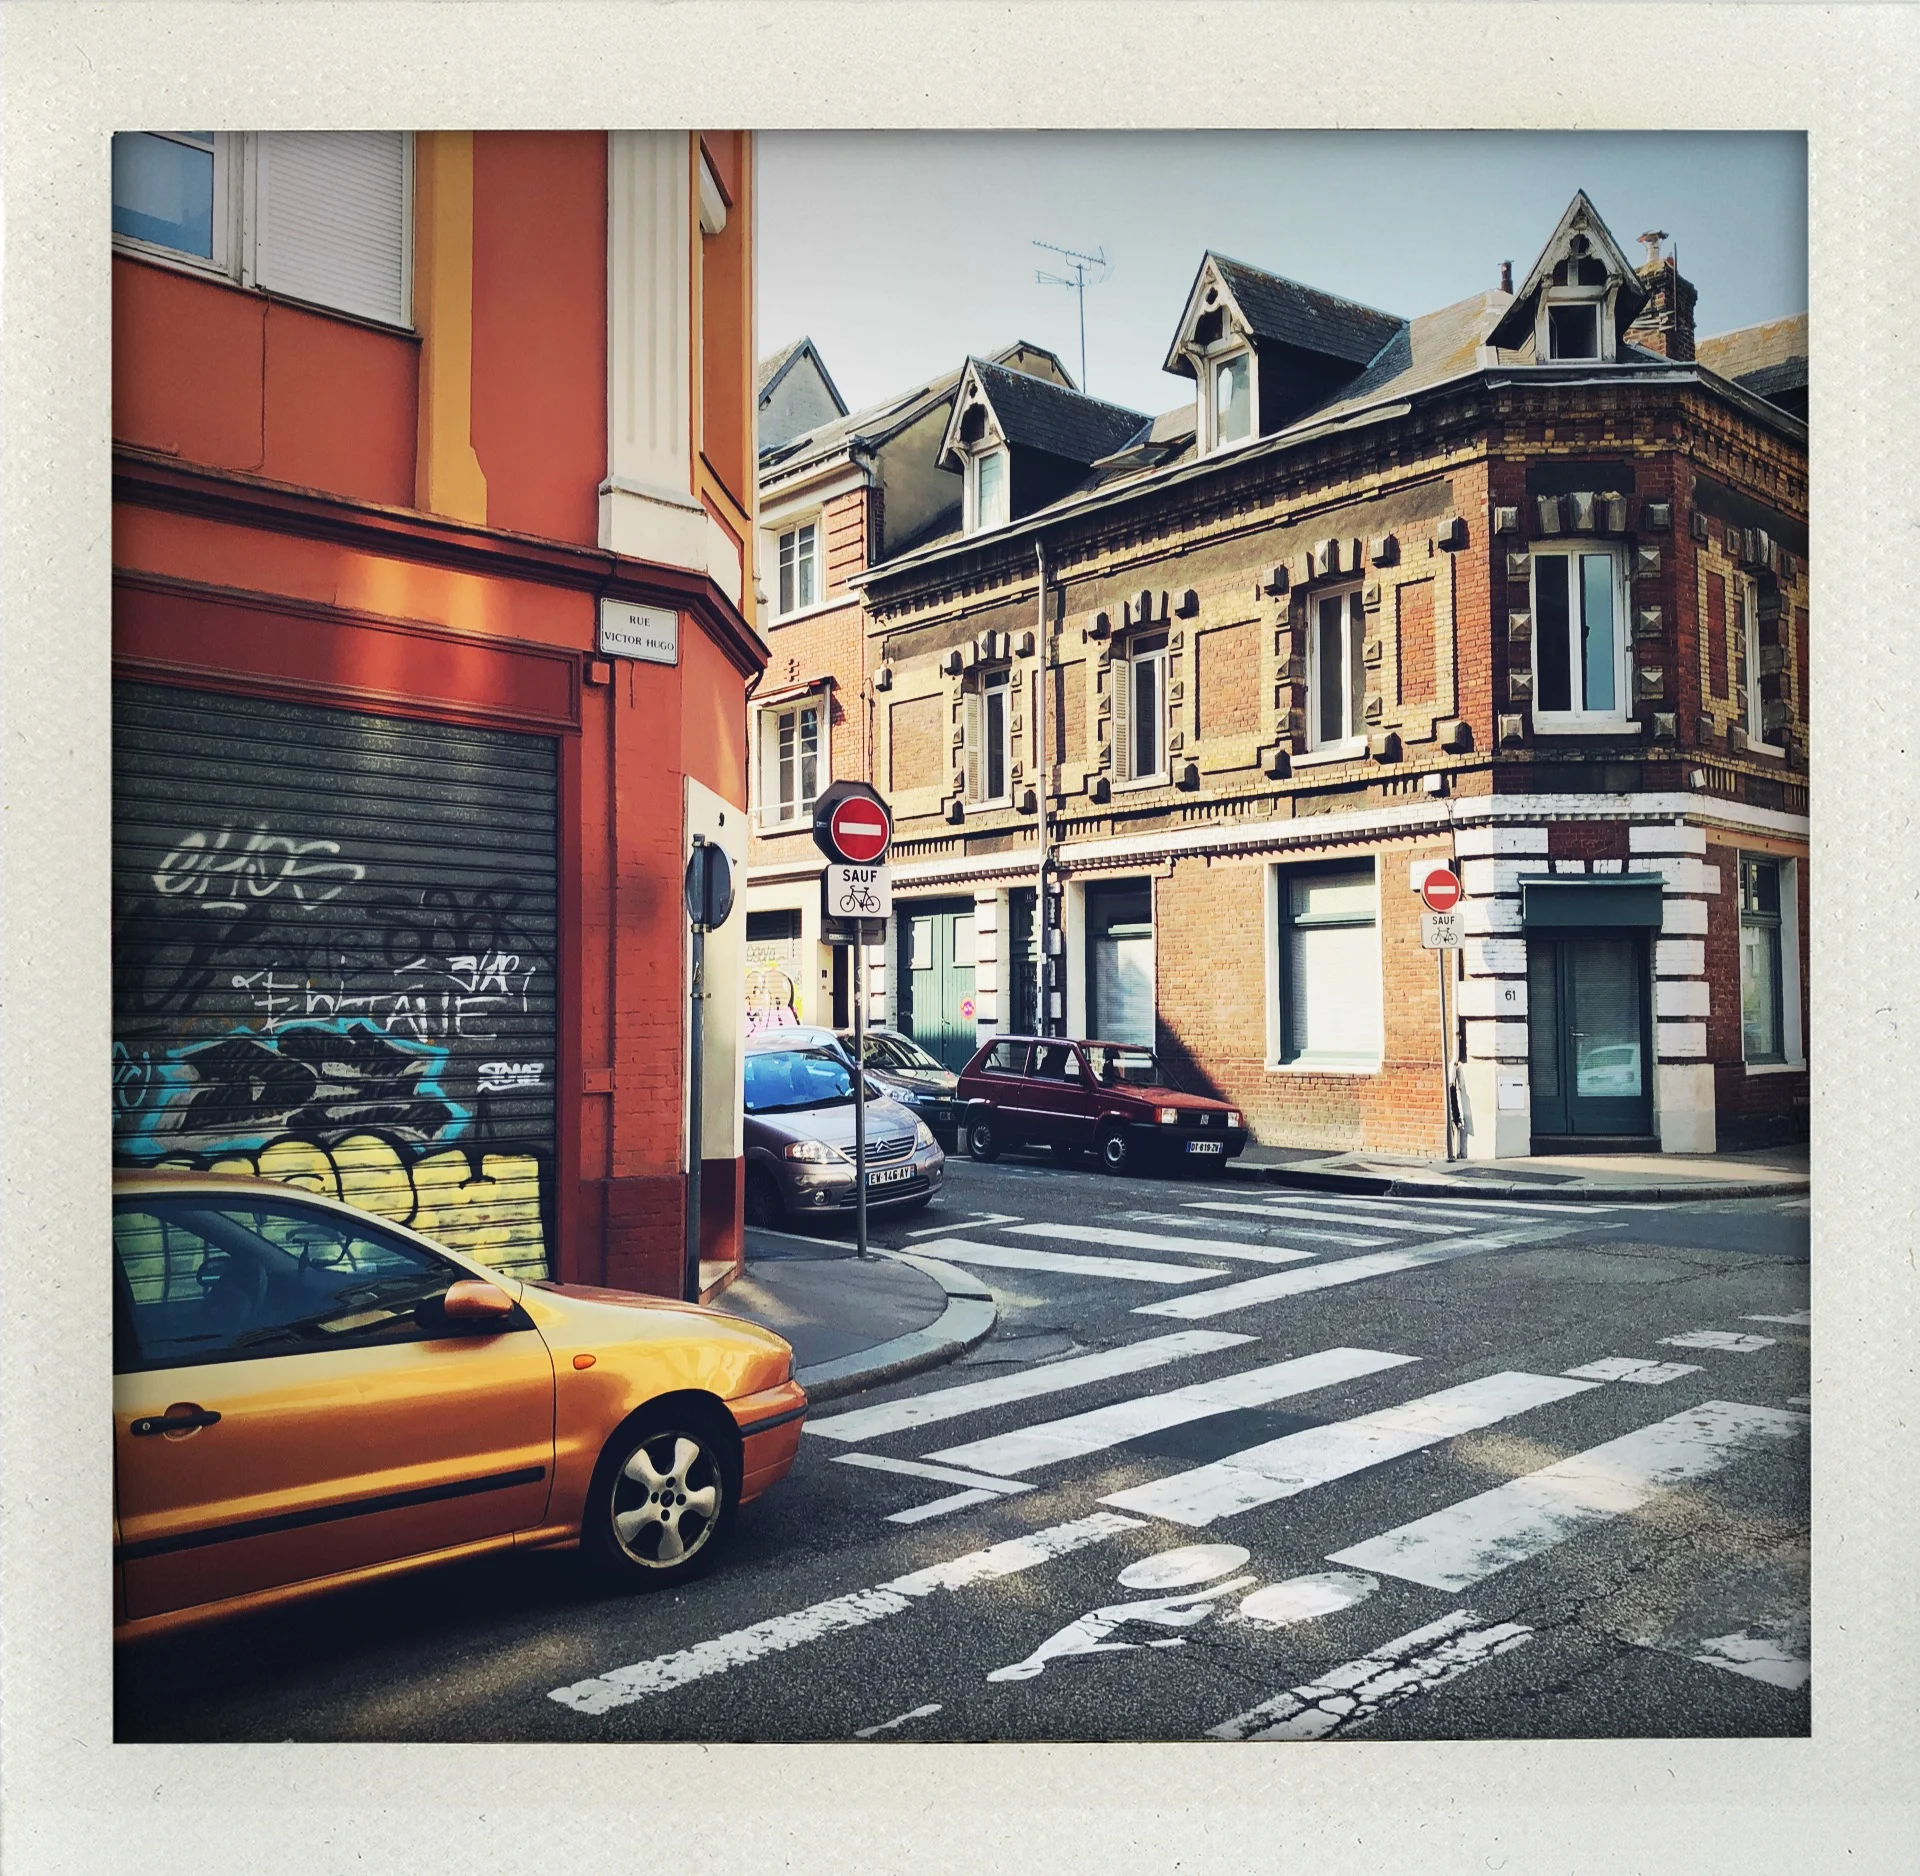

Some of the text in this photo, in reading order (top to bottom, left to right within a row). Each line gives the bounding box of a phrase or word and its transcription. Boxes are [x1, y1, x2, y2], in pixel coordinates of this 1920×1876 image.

[629, 615, 651, 627] RUE
[604, 631, 675, 651] VICTOR HUGO
[842, 868, 878, 883] SAUF
[1432, 915, 1455, 925] SAUF
[1505, 990, 1516, 1001] 61
